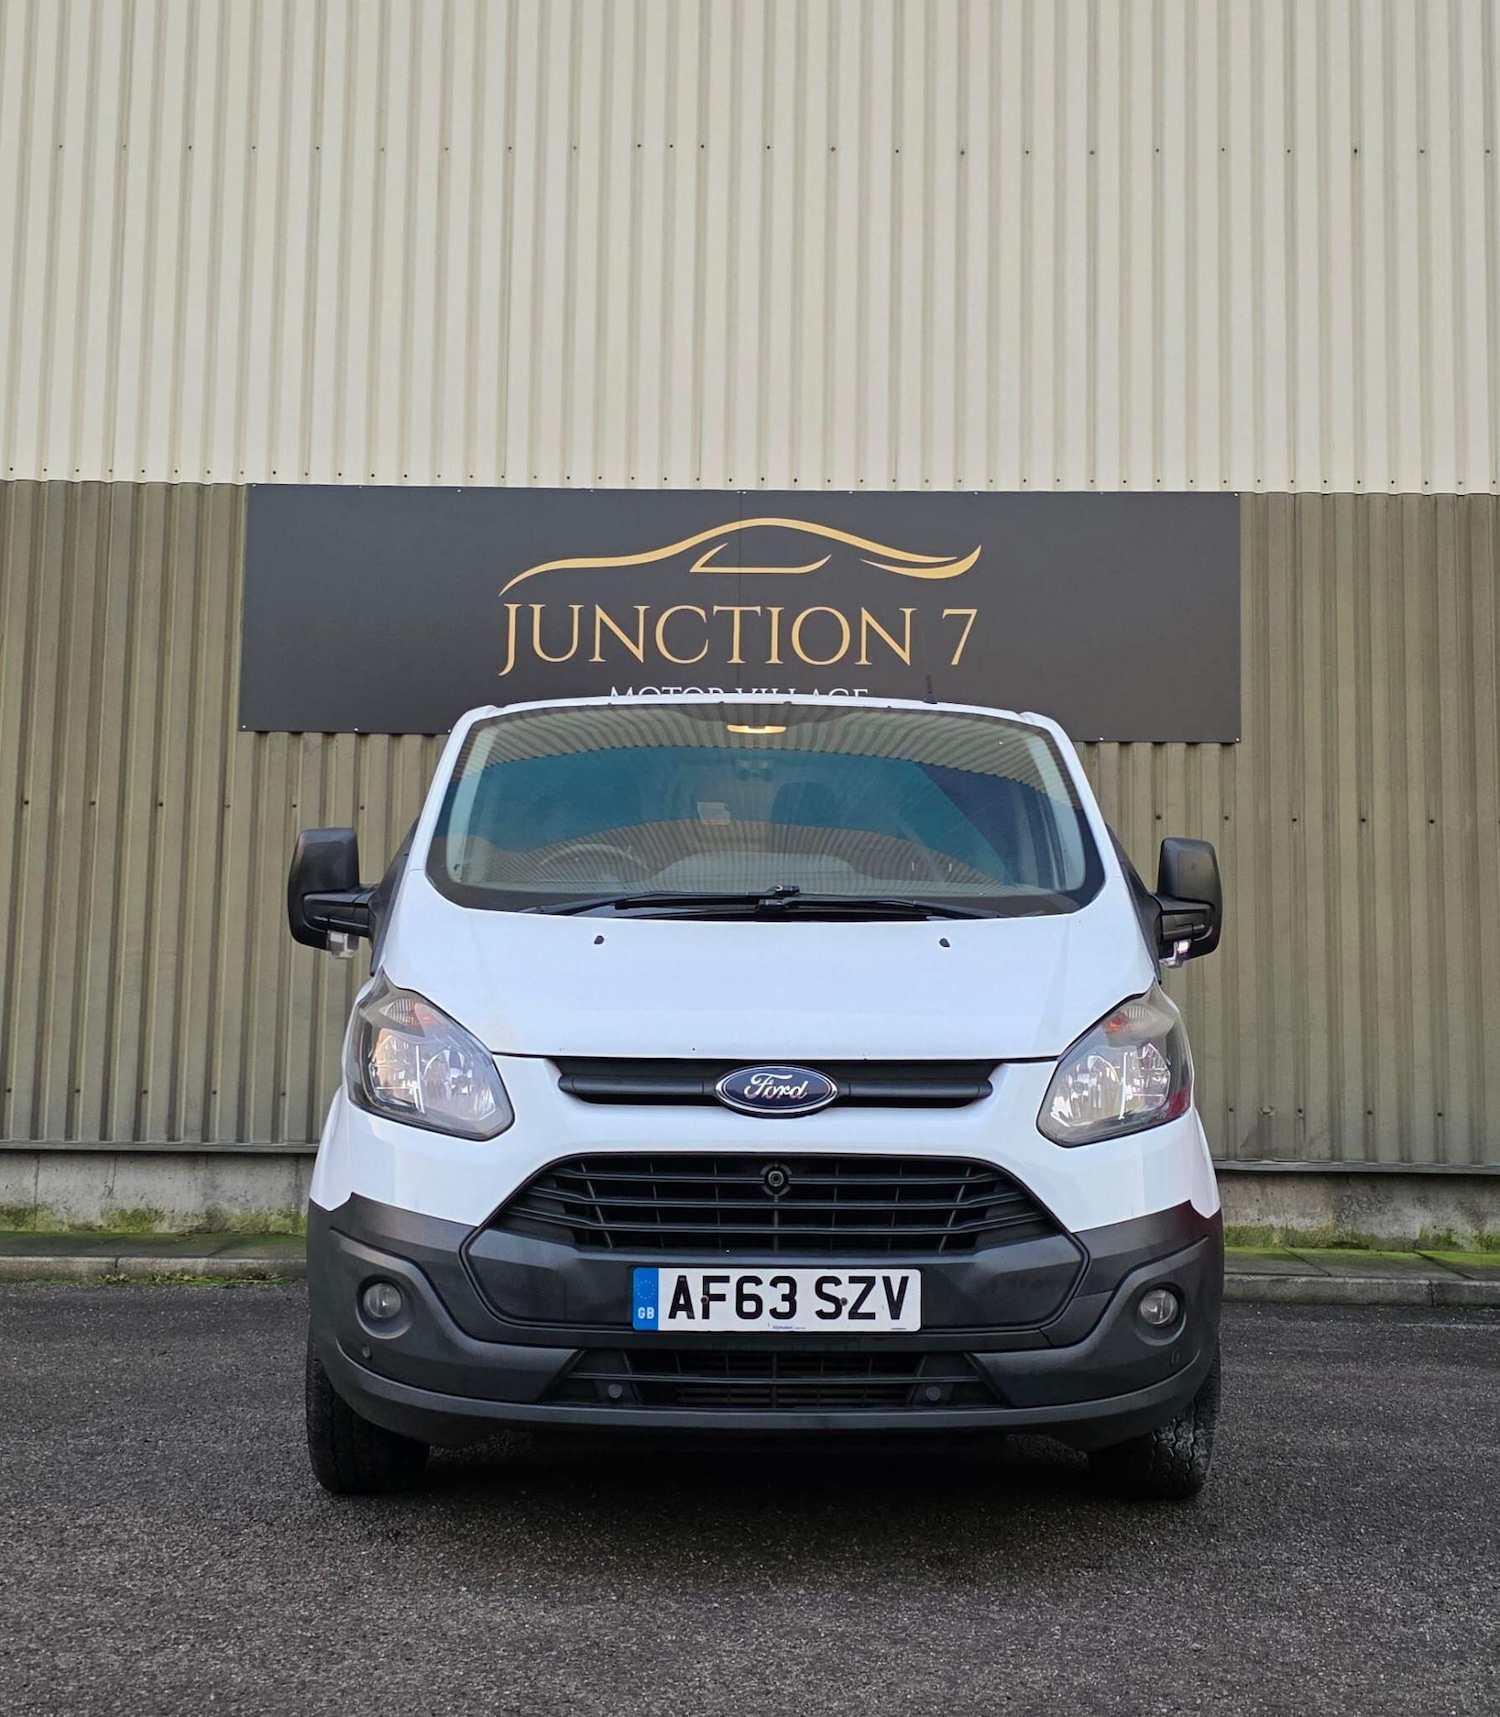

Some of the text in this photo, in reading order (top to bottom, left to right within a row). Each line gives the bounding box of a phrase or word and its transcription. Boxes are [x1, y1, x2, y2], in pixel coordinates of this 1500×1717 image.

[499, 603, 978, 676] JUNCTION 7
[744, 1073, 808, 1100] Ford
[637, 1306, 655, 1320] GB
[668, 1275, 910, 1321] AF63 SZV
